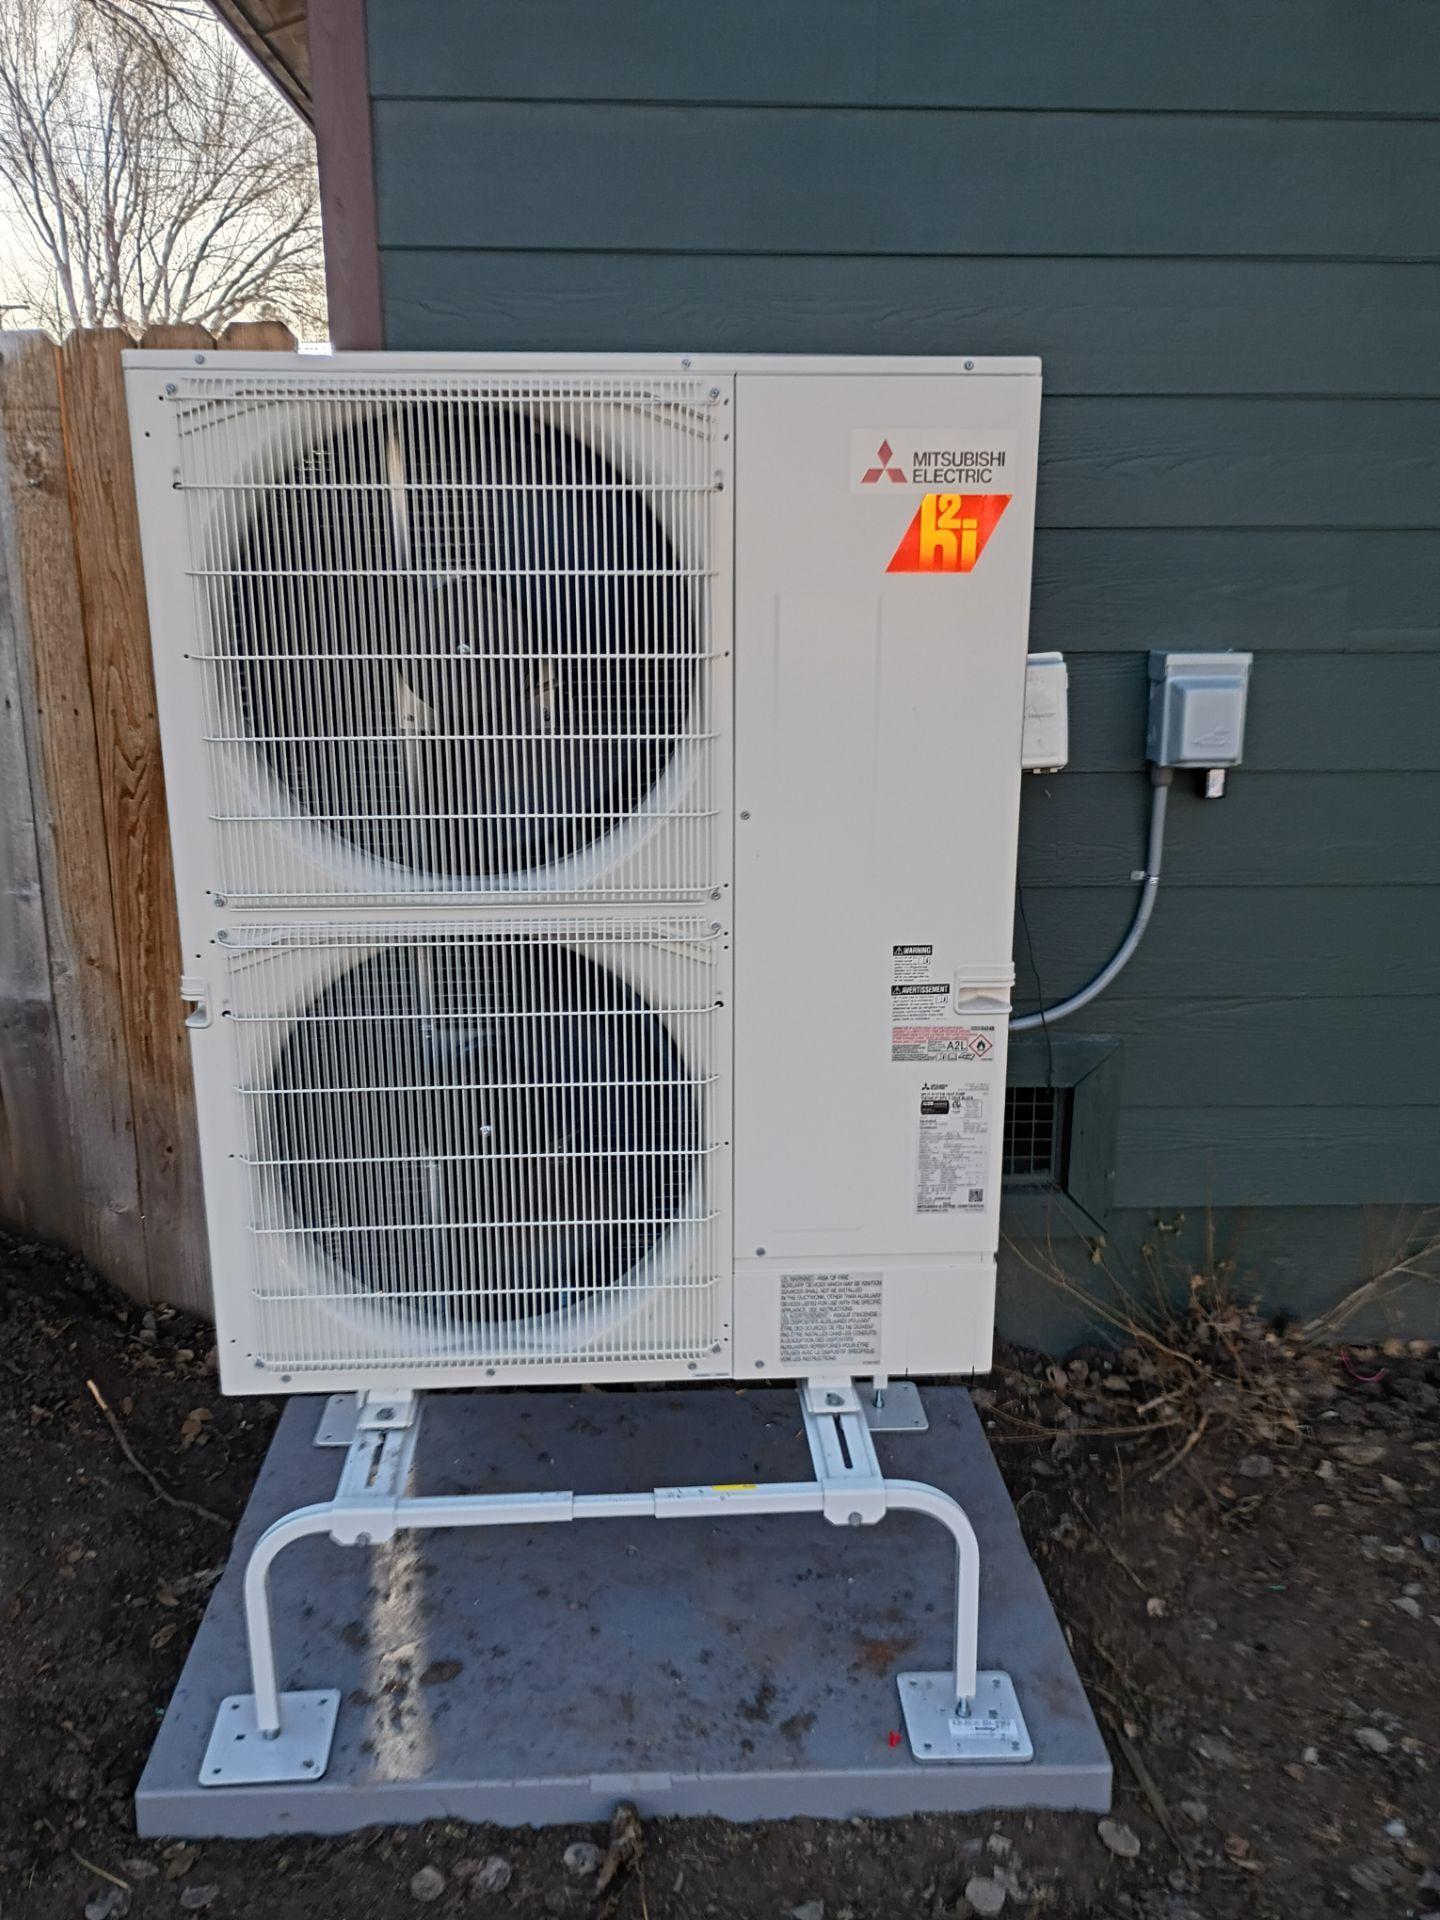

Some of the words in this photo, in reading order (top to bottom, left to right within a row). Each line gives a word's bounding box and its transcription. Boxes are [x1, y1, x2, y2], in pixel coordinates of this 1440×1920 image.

[913, 451, 1006, 467] MITSUBISHI
[913, 468, 993, 484] ELECTRIC
[903, 946, 931, 954] WARNING
[901, 985, 948, 994] AVERTISSEMENT
[946, 1041, 968, 1051] A2L
